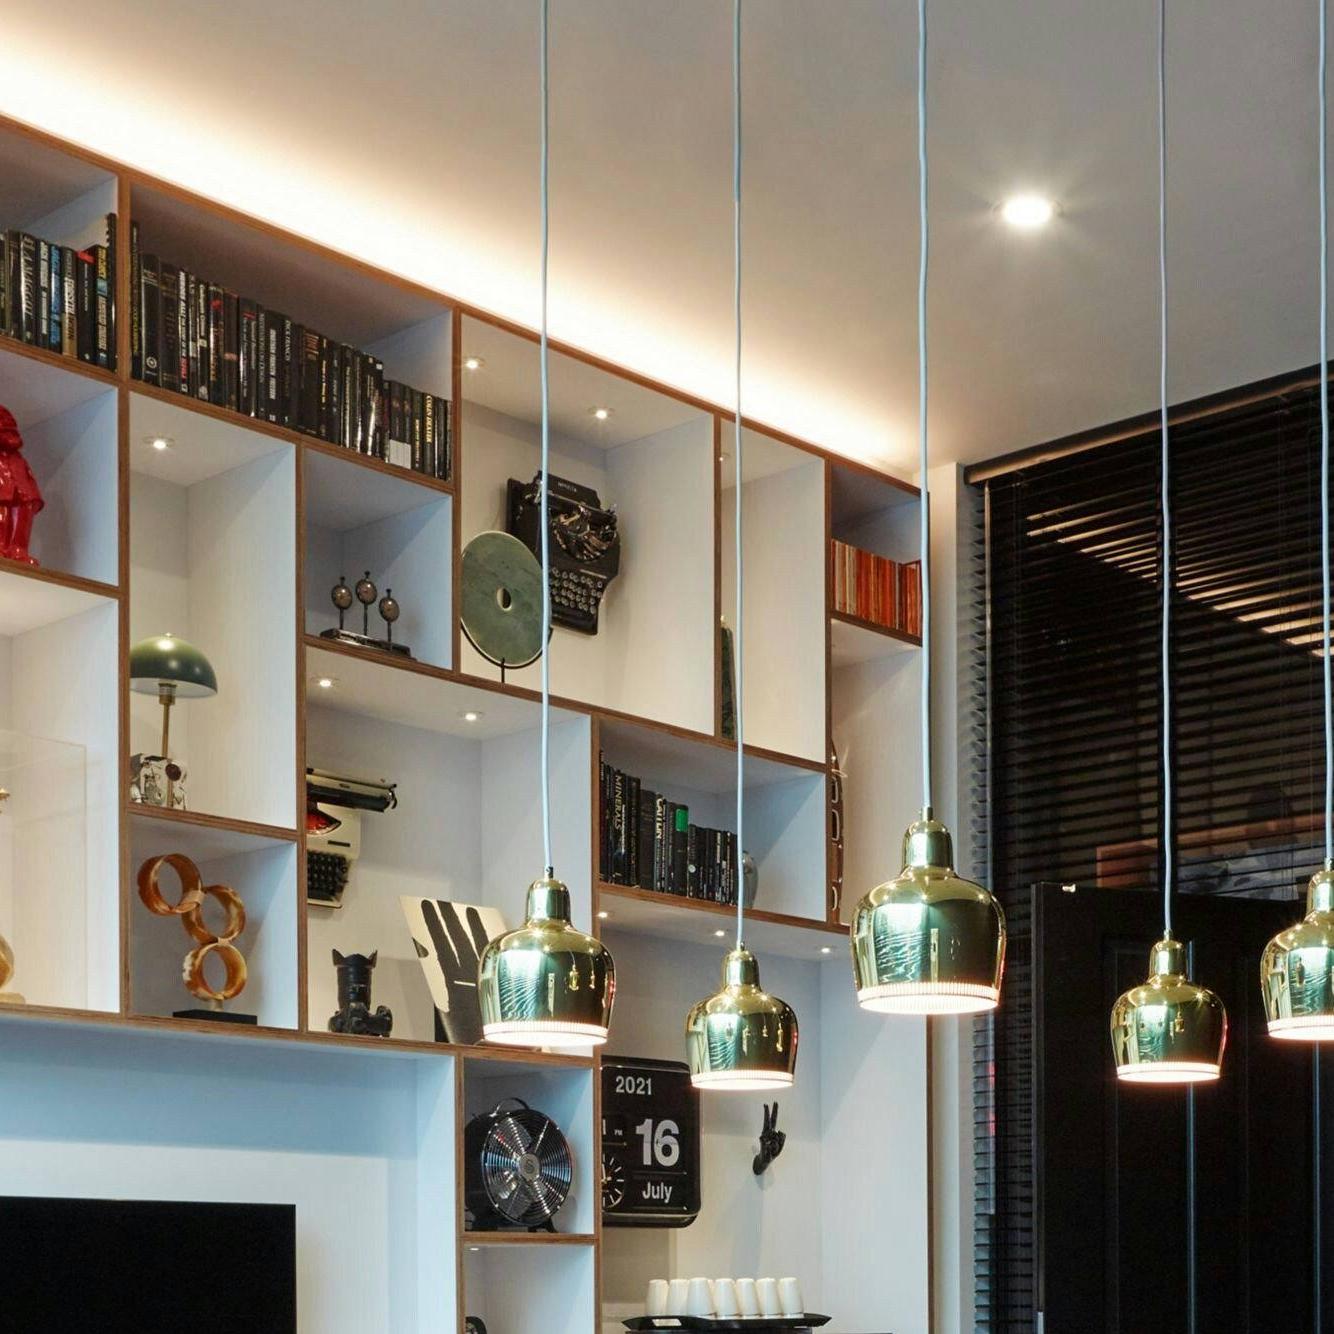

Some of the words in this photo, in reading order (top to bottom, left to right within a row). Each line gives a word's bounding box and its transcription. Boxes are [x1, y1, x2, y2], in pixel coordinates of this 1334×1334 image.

[616, 1076, 652, 1096] 2021
[636, 1118, 680, 1167] 16
[643, 1182, 673, 1204] July
